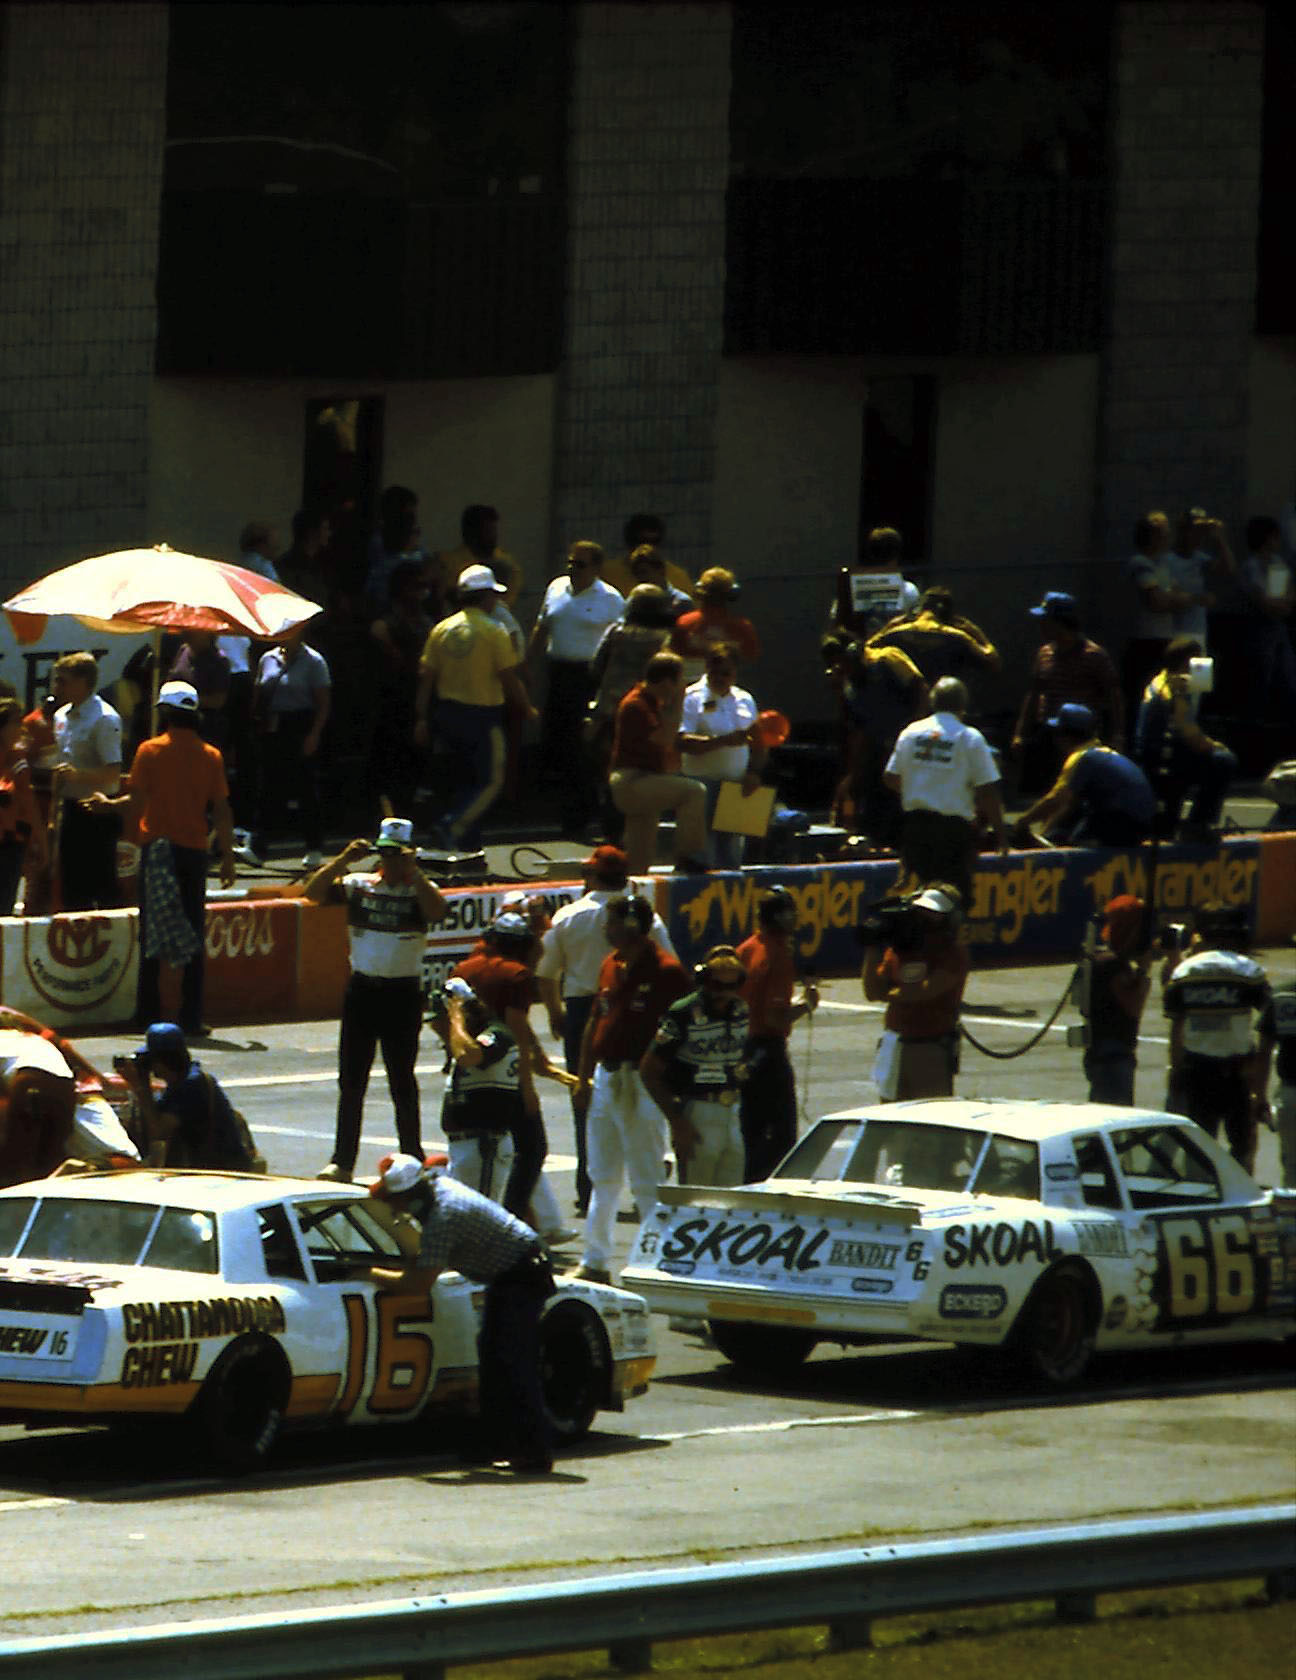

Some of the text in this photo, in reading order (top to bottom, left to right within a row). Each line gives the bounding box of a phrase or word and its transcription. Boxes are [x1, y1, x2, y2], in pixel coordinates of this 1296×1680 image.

[662, 1218, 830, 1272] SKOAL
[827, 1238, 902, 1271] BANDIT
[943, 1219, 1062, 1269] SKOAL
[1160, 1214, 1255, 1315] 66
[49, 1329, 69, 1356] 16
[121, 1296, 287, 1342] CHATTANOOGA
[120, 1341, 199, 1388] CHEW
[340, 1291, 435, 1418] 16
